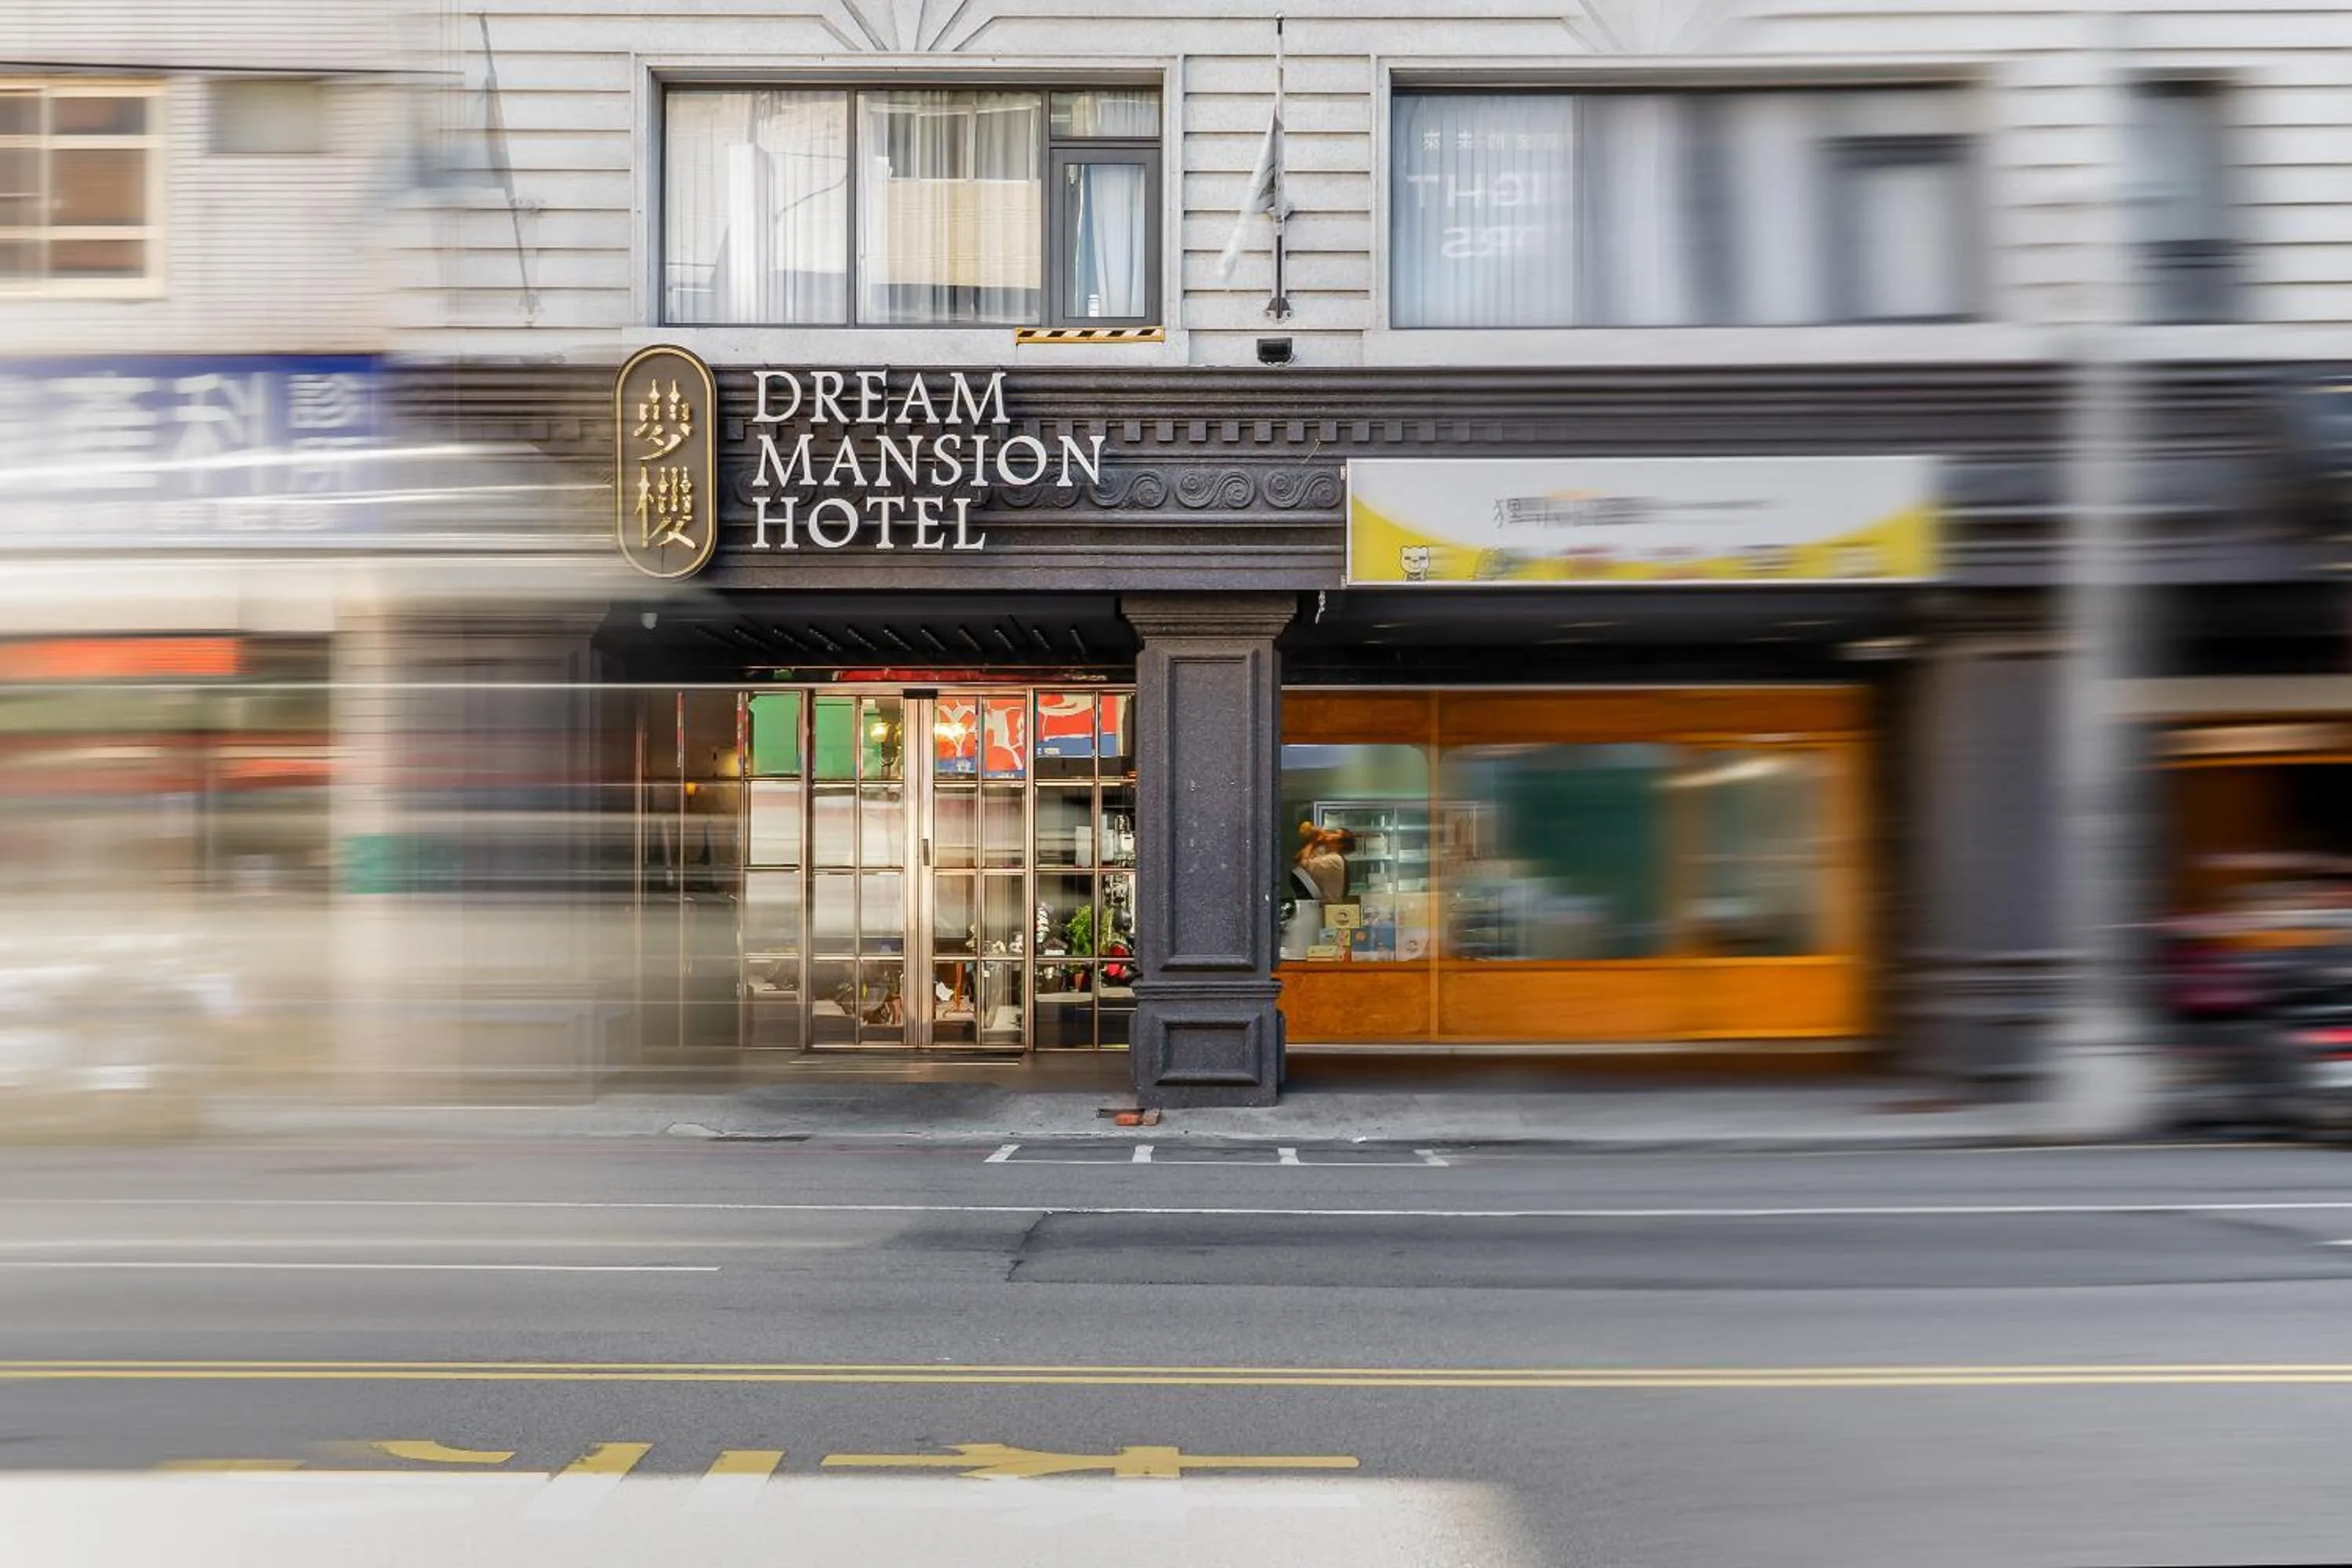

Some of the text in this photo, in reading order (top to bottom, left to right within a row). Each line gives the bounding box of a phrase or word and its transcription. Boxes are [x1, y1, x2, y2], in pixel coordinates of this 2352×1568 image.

[753, 370, 1011, 424] DREAM
[752, 434, 1107, 488] MANSION
[752, 496, 986, 550] HOTEL
